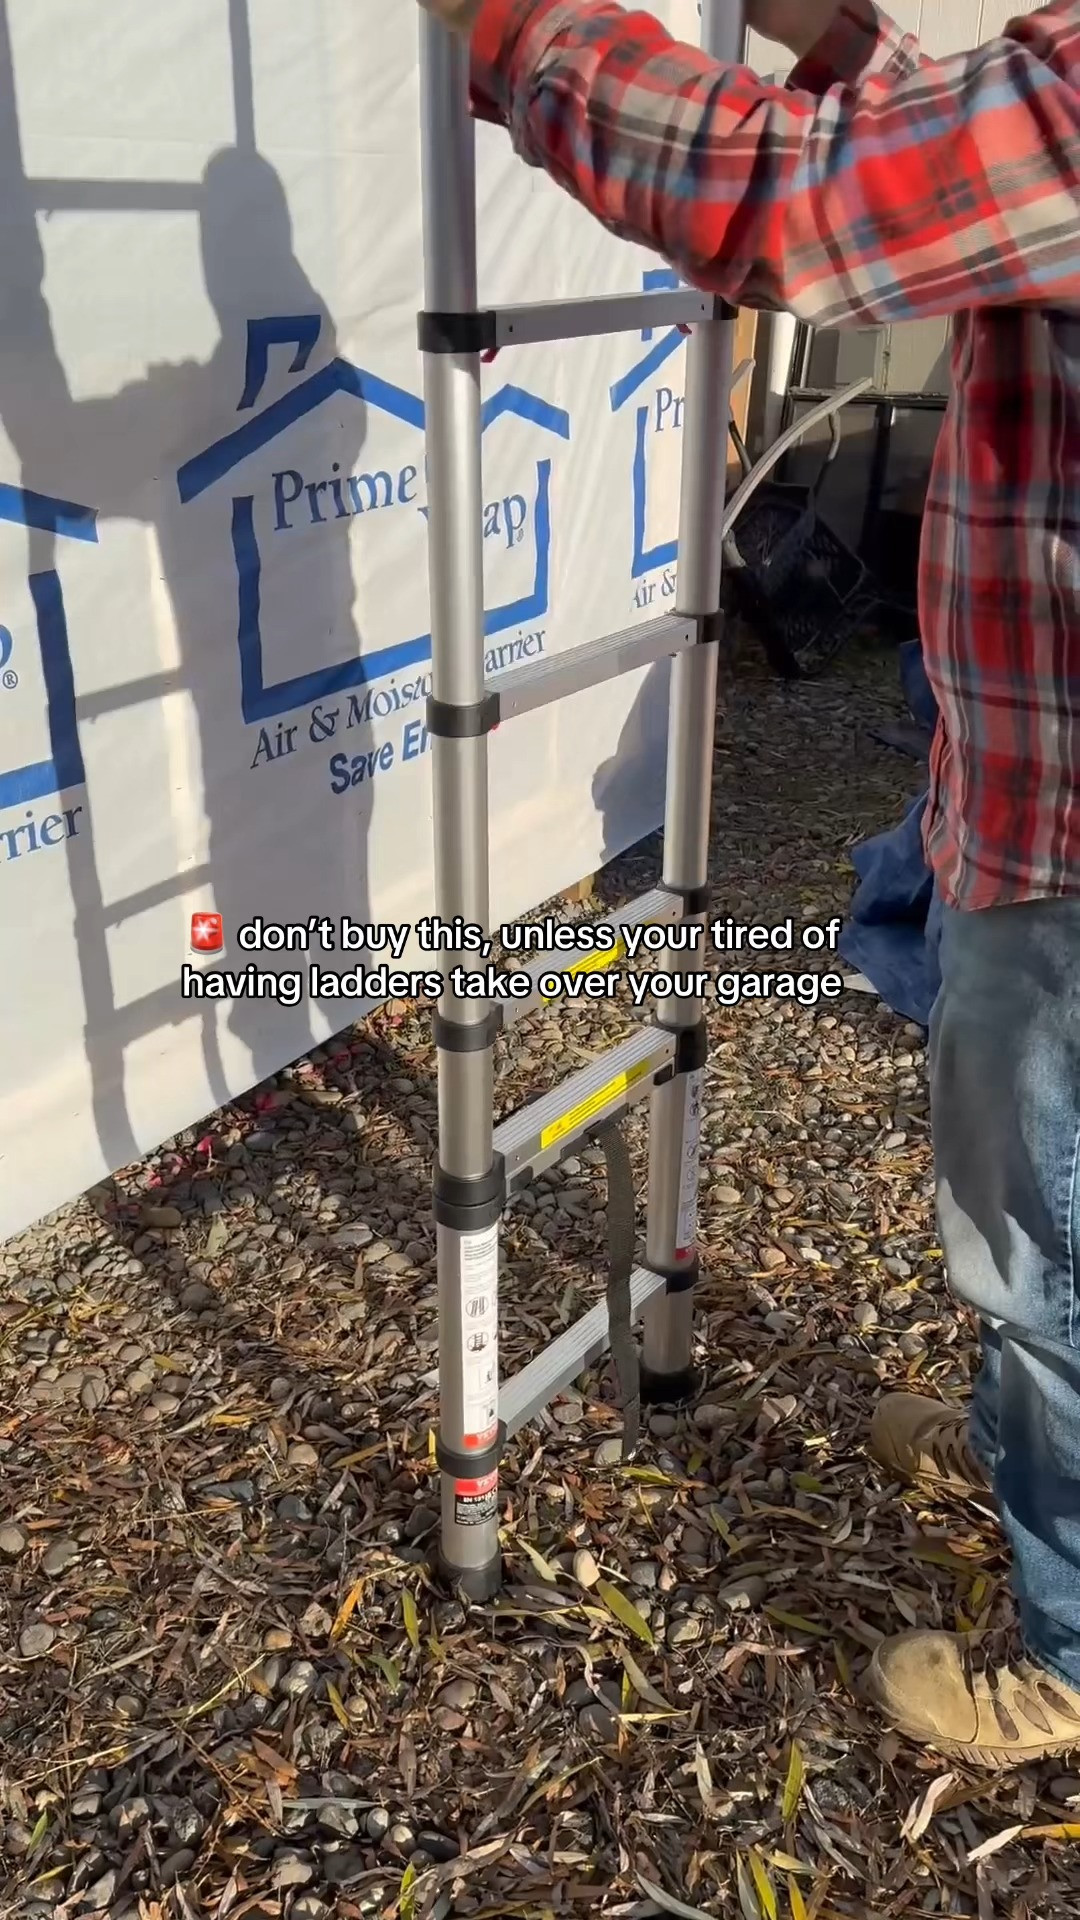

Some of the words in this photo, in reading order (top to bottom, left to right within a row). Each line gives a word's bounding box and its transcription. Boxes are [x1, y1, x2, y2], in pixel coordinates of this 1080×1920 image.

[655, 387, 685, 432] Pr
[271, 462, 418, 531] Prime
[250, 722, 298, 769] Air
[309, 705, 340, 743] &
[346, 672, 433, 729] Moistu
[484, 630, 547, 673] arrier
[329, 741, 394, 795] Save
[402, 719, 434, 761] En
[0, 805, 83, 863] rier
